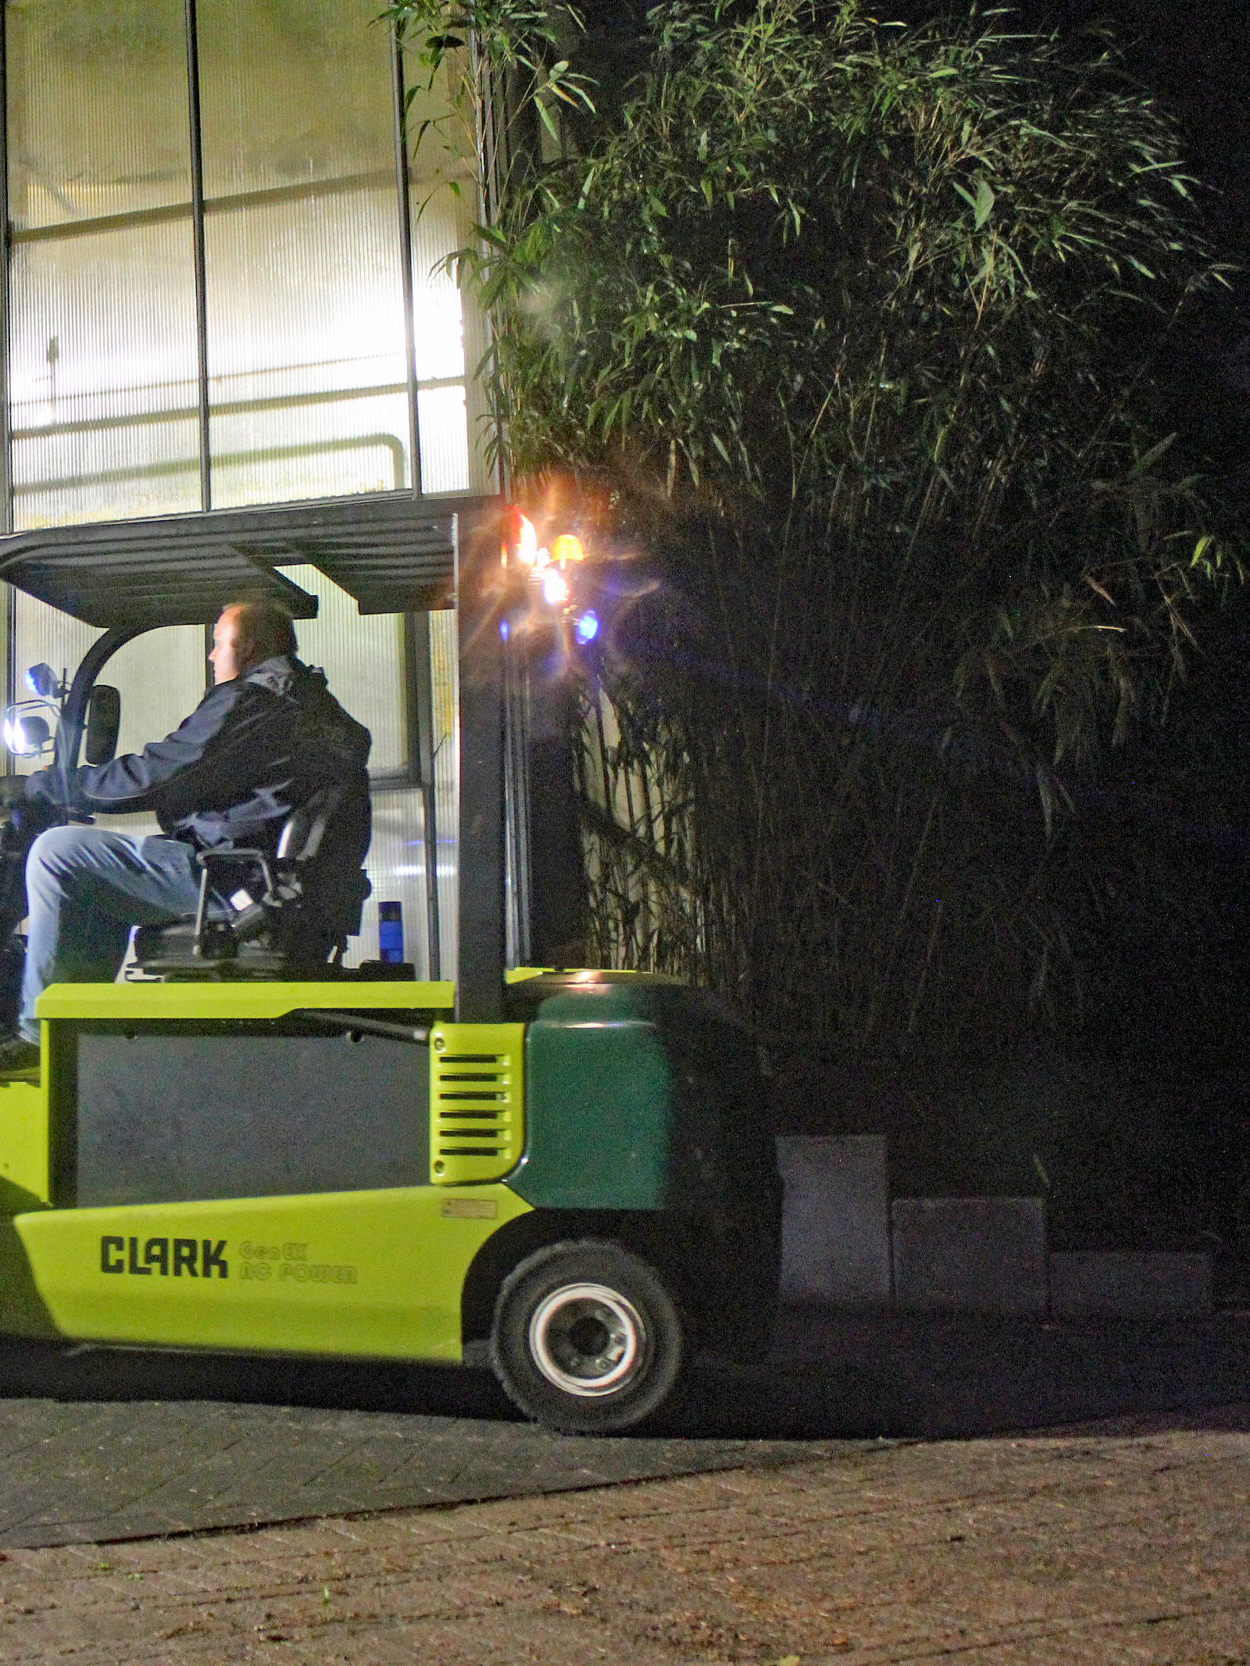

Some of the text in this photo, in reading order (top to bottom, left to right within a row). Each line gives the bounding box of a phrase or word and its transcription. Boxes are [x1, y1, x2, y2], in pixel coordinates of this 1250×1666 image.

[101, 1235, 229, 1279] CLARK
[238, 1260, 359, 1285] AC POWER
